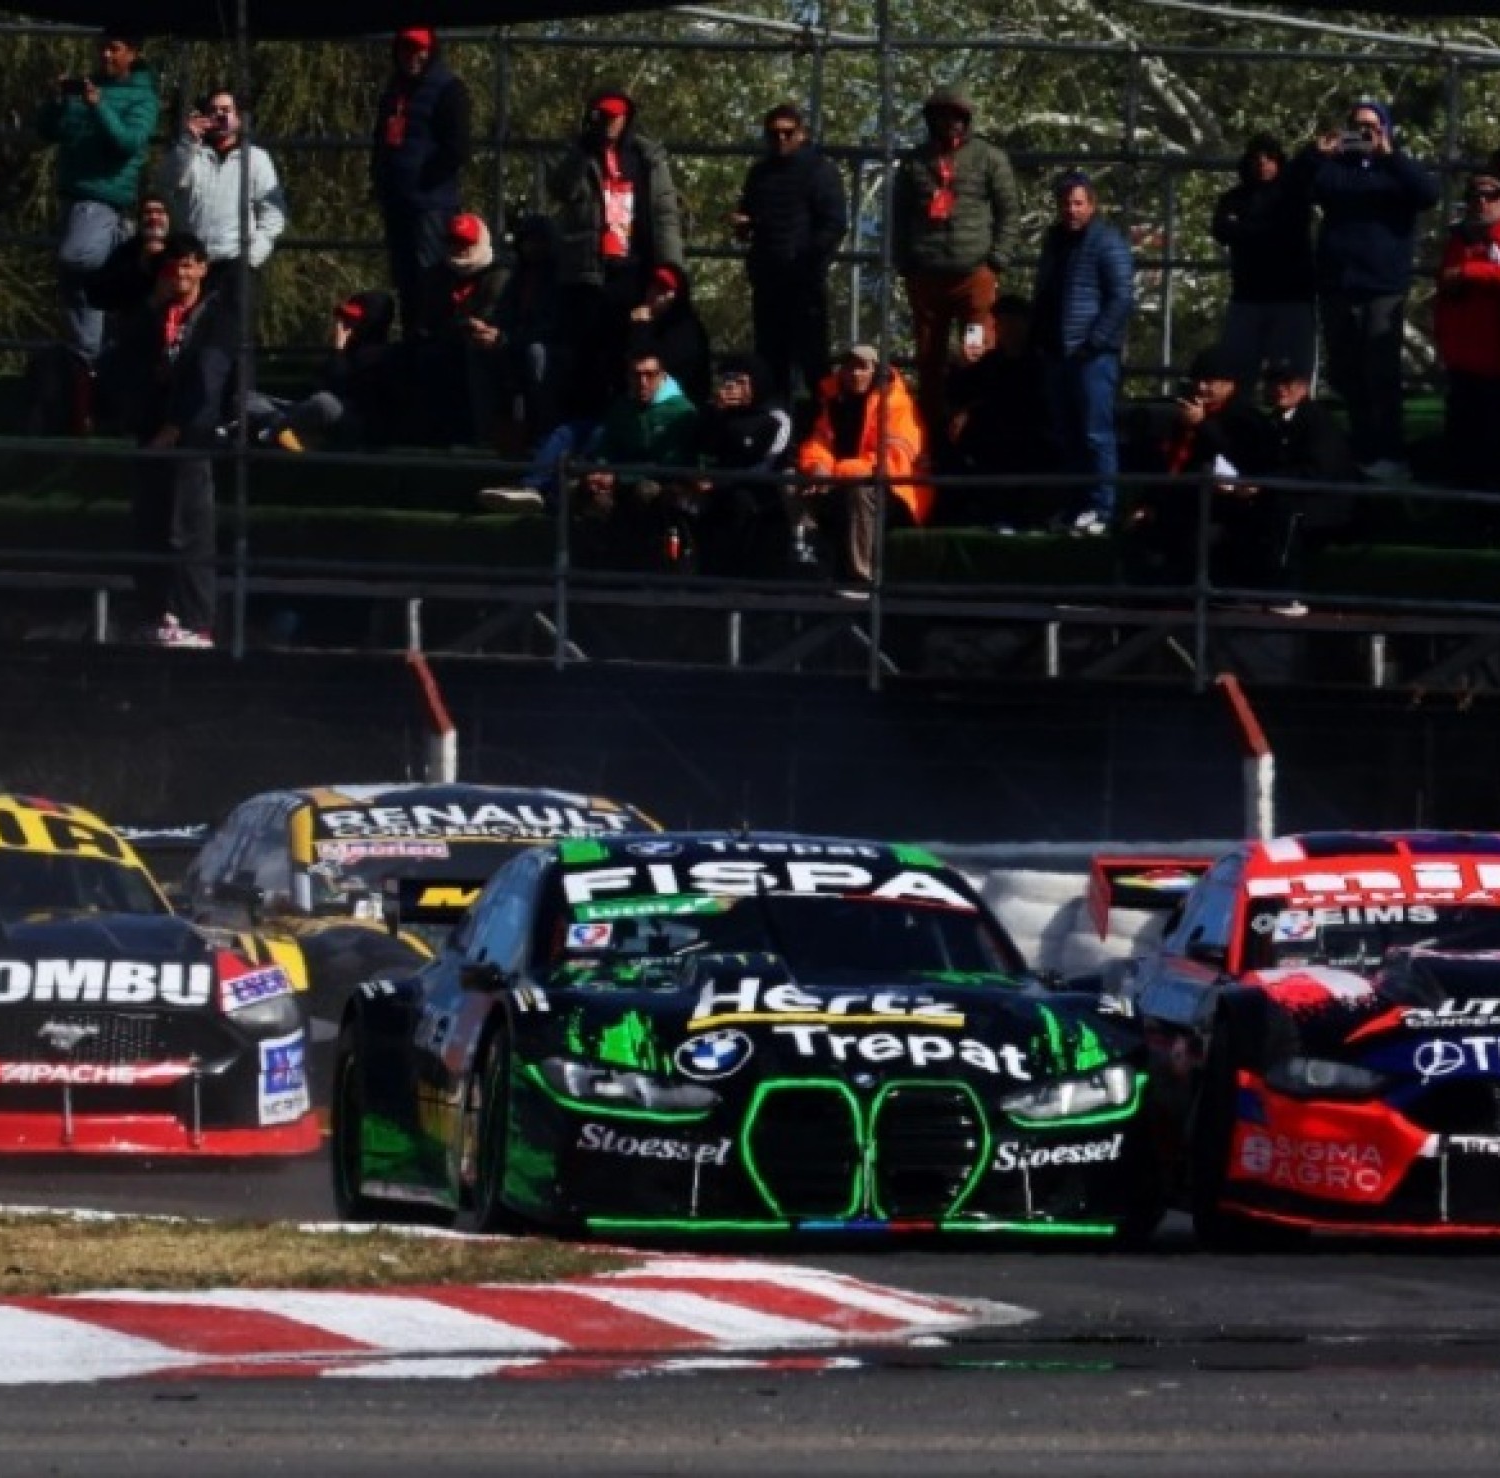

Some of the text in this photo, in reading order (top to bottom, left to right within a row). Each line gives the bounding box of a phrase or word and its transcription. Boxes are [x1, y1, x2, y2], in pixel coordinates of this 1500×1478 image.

[320, 803, 630, 832] RENAULT
[700, 841, 881, 859] Trepat
[563, 861, 978, 909] FISPA
[691, 977, 966, 1018] Hertz
[771, 1024, 1032, 1081] Trepat
[576, 1123, 733, 1165] Stoessel
[1274, 1134, 1382, 1168] SIGMA
[1273, 1160, 1382, 1192] AGRO
